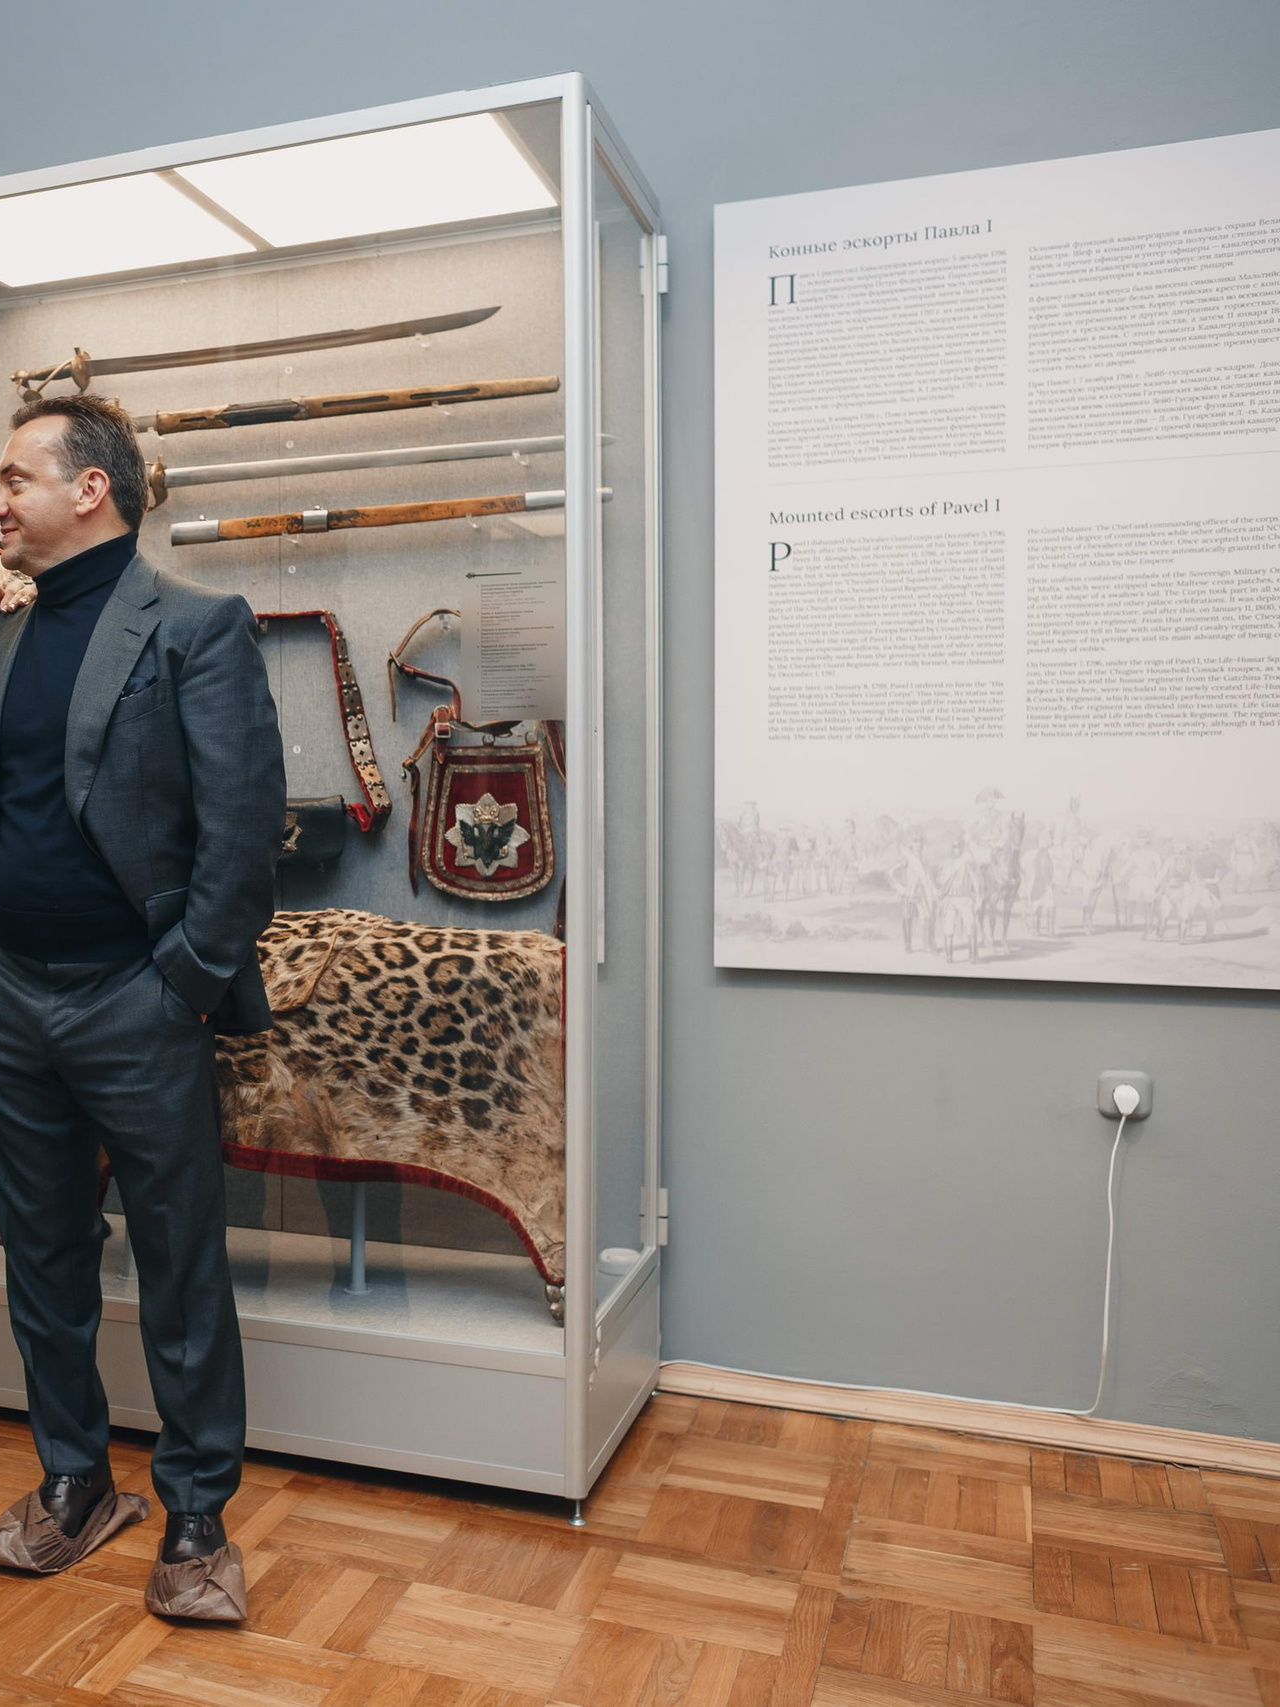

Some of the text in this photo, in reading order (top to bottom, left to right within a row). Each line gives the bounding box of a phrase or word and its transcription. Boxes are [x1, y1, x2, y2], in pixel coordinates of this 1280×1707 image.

[769, 219, 992, 259] Конные эскорты Павла I
[769, 273, 796, 306] П
[769, 498, 1000, 525] Mounted escorts of Pavel I
[770, 542, 792, 572] P
